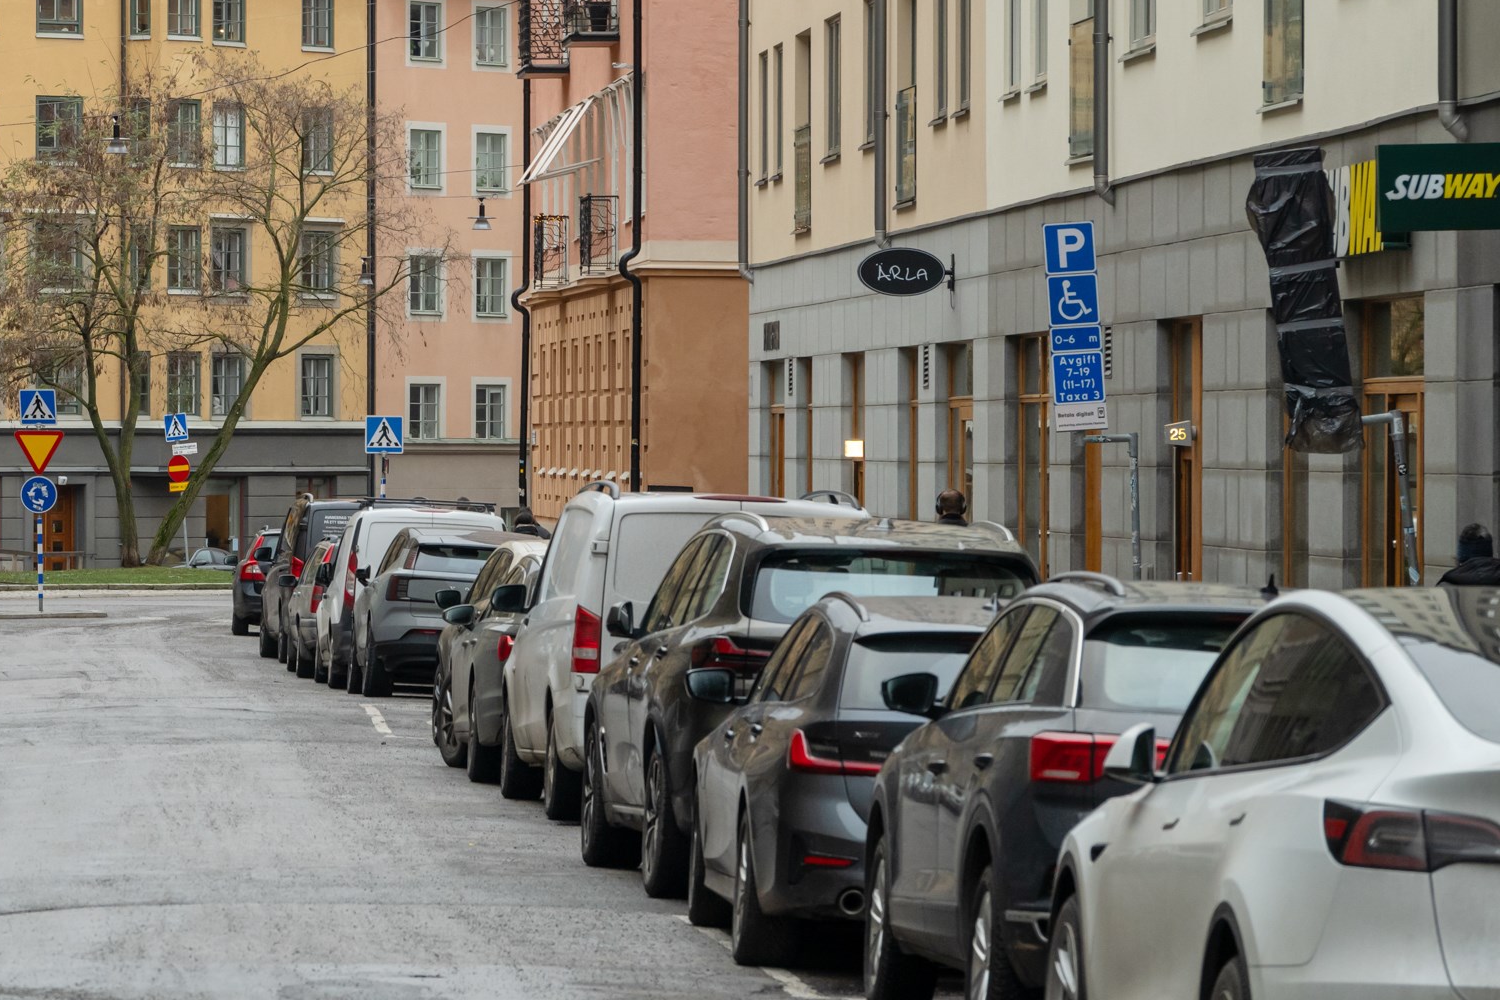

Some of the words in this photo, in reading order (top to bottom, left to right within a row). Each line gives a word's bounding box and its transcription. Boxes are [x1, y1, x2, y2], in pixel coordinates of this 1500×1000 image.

[1385, 173, 1500, 201] SUBWAY
[1324, 159, 1383, 257] UBWA
[1057, 228, 1085, 268] P
[875, 262, 928, 281] ÄRLA
[1088, 335, 1098, 343] m
[1059, 354, 1096, 367] Avgift
[1066, 367, 1090, 377] 7-19
[1062, 378, 1095, 390] (11-17)
[1059, 392, 1089, 402] Taxa
[1093, 390, 1100, 400] 3
[1169, 427, 1187, 441] 25
